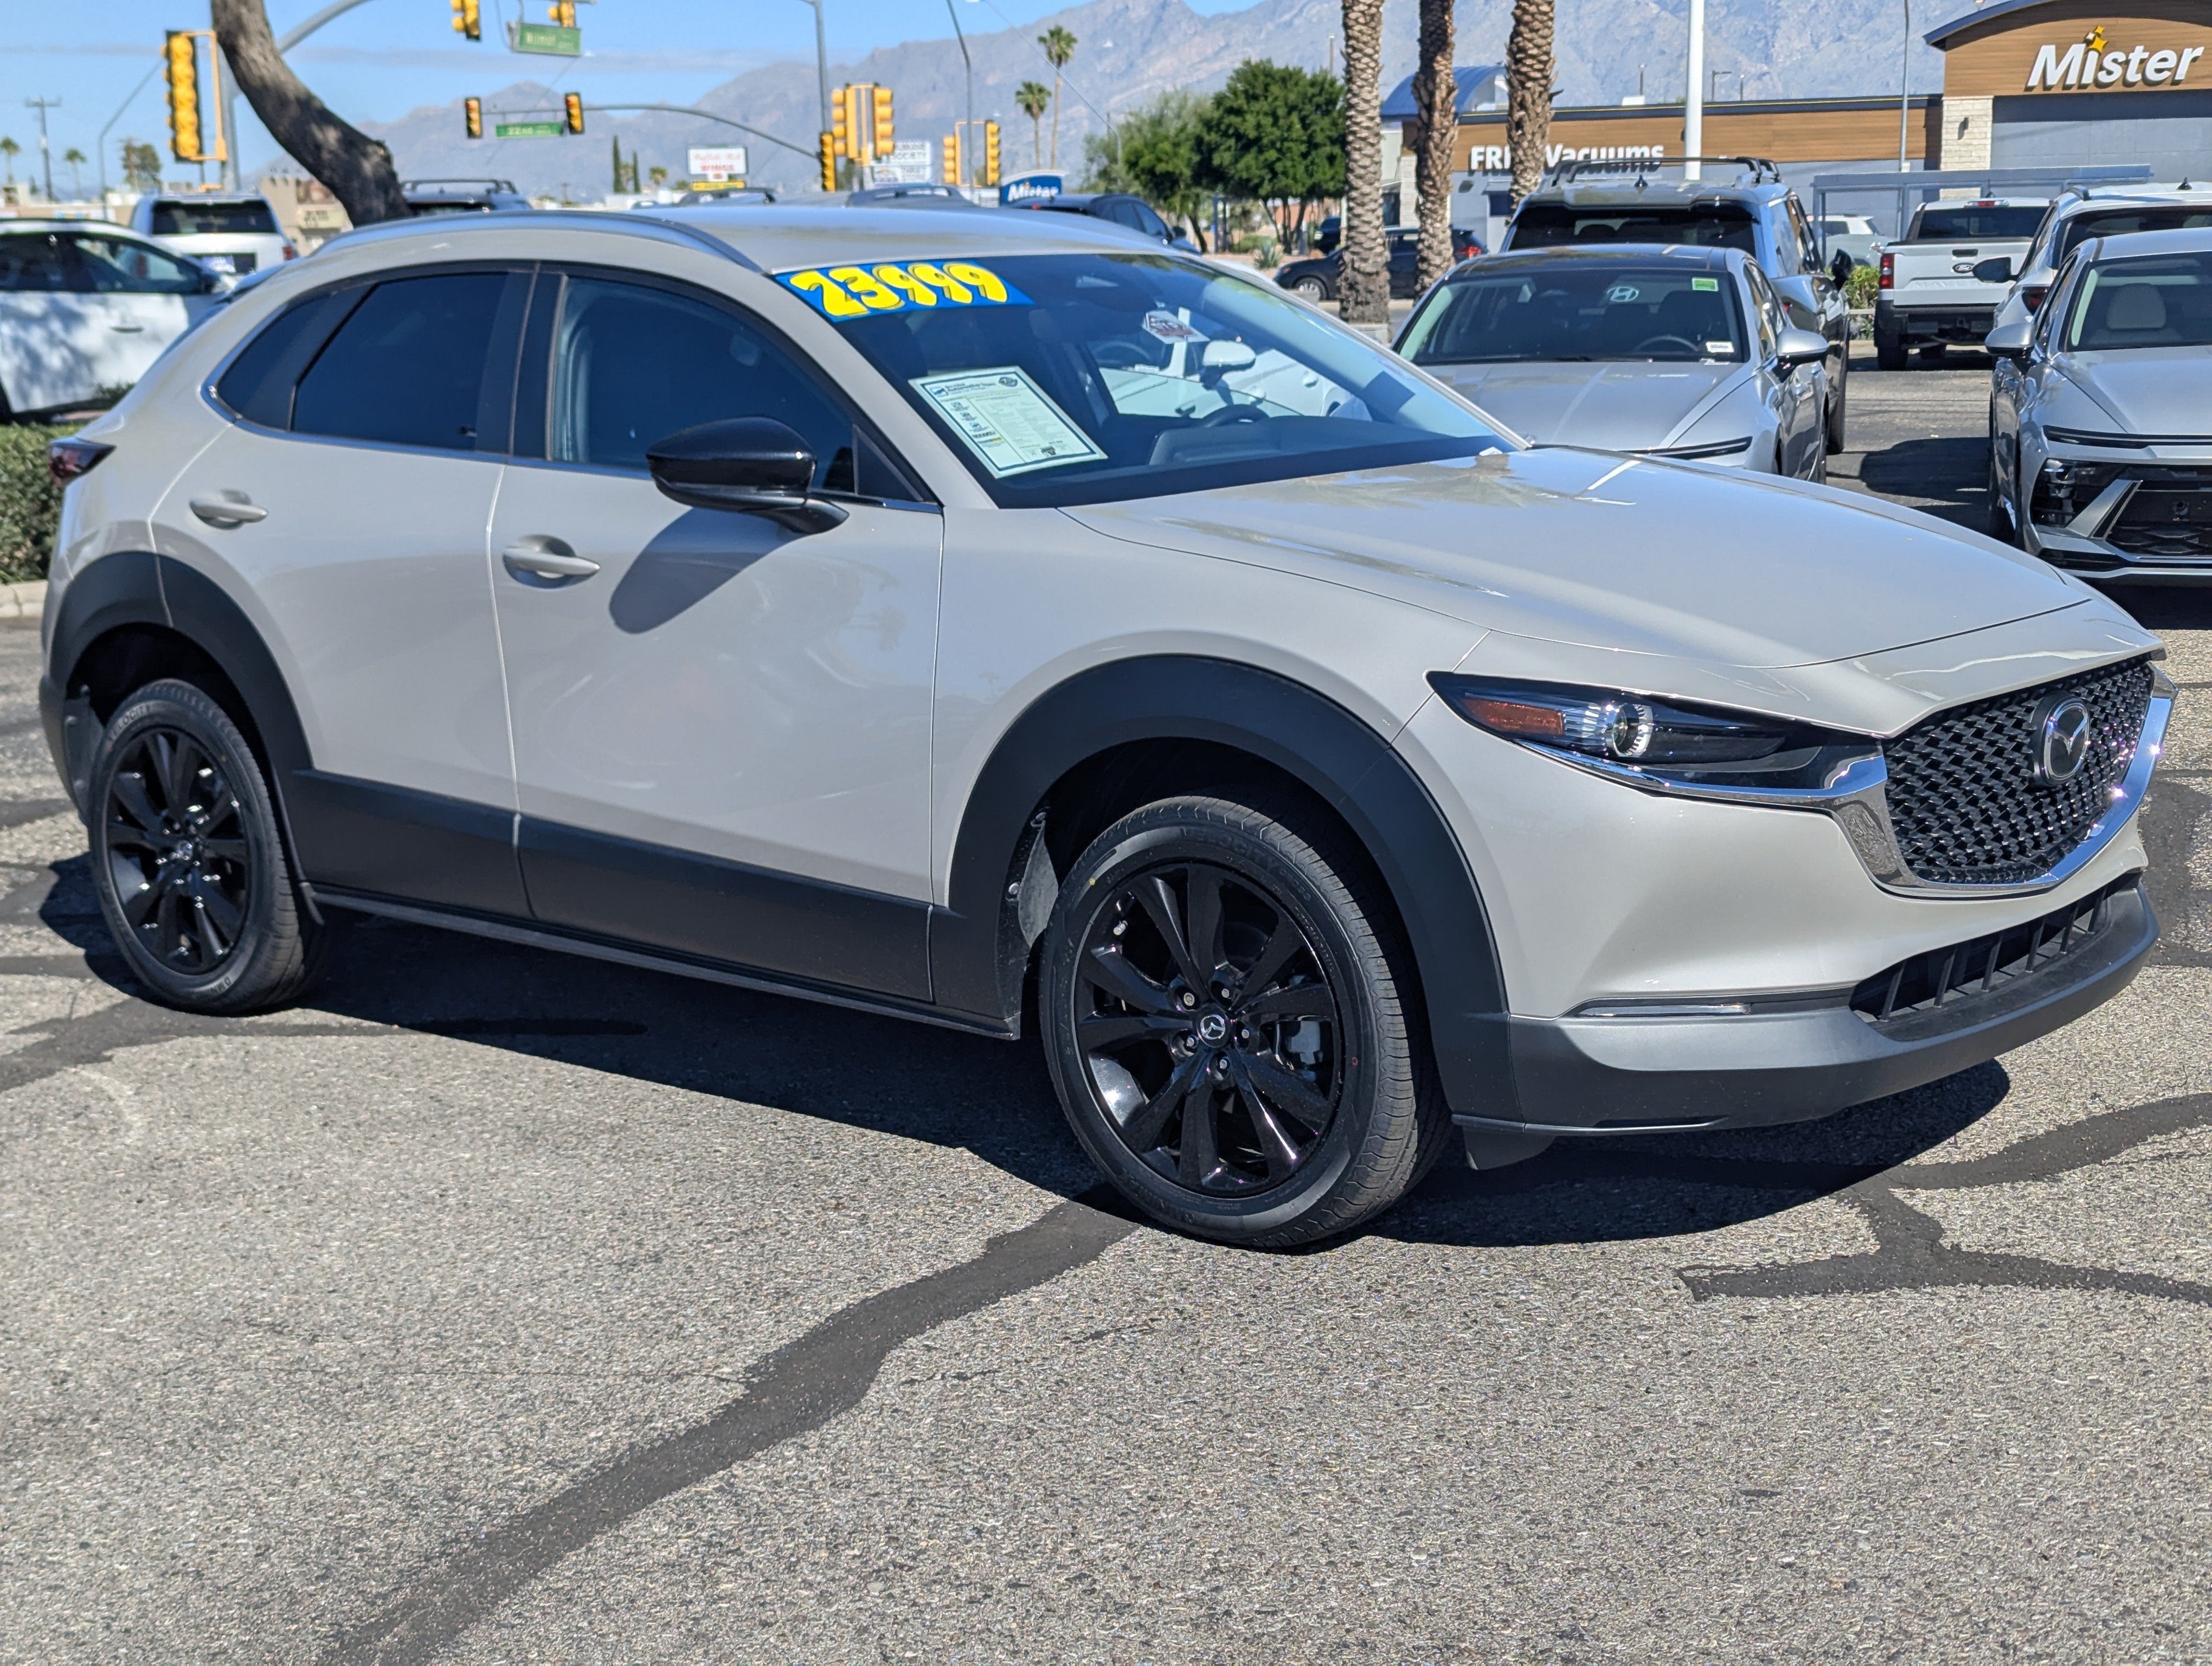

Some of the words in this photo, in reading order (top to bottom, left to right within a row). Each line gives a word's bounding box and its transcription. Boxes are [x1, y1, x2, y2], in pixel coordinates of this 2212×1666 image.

[2027, 43, 2205, 87] Mister
[1545, 143, 1664, 168] Vacuums
[1007, 183, 1059, 202] Mister
[789, 262, 1008, 317] 23999
